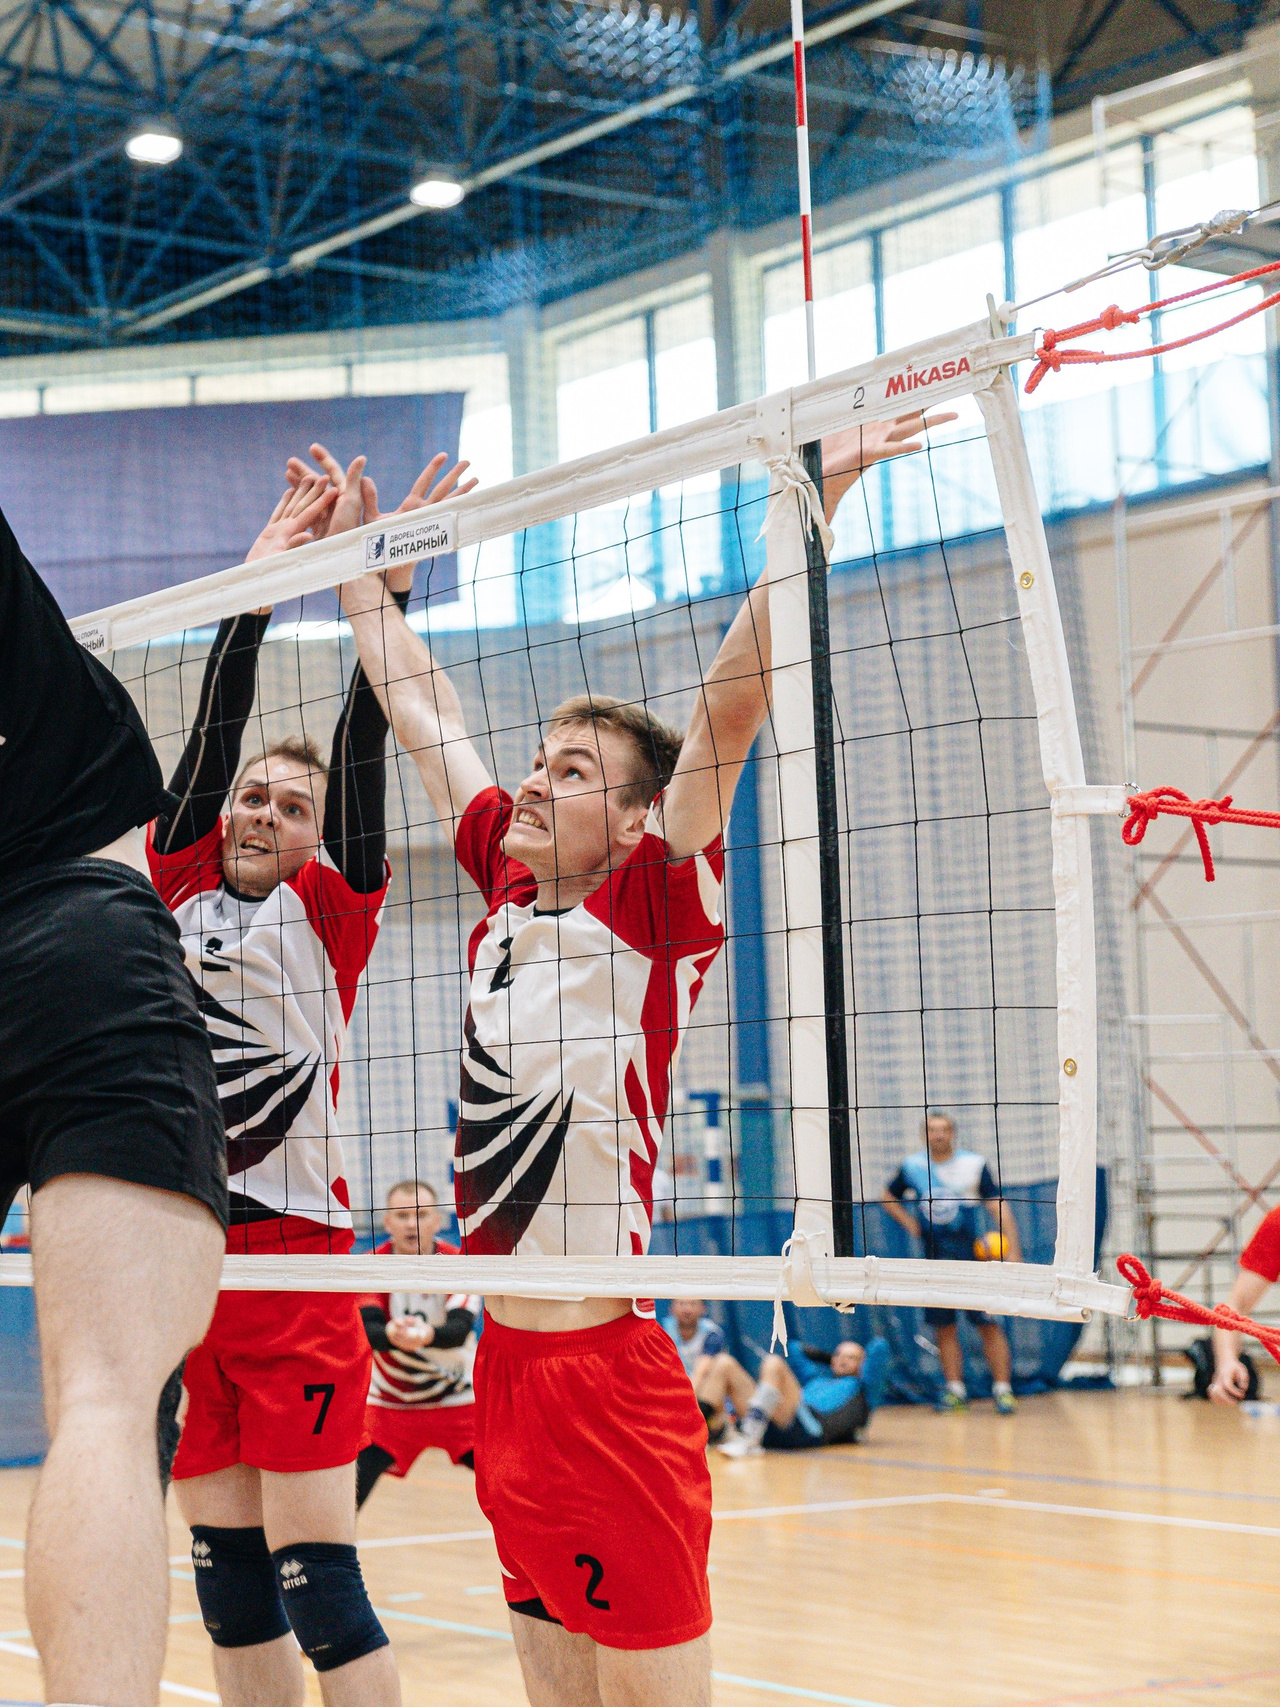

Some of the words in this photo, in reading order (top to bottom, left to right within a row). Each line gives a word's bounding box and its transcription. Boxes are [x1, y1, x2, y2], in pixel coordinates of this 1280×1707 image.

[852, 386, 866, 410] 2
[389, 529, 415, 543] ДВОРЕЦ
[415, 523, 440, 536] СПОРТА
[389, 530, 449, 559] ЯНТАРНЫЙ
[303, 1383, 336, 1435] 7
[574, 1553, 611, 1611] 2
